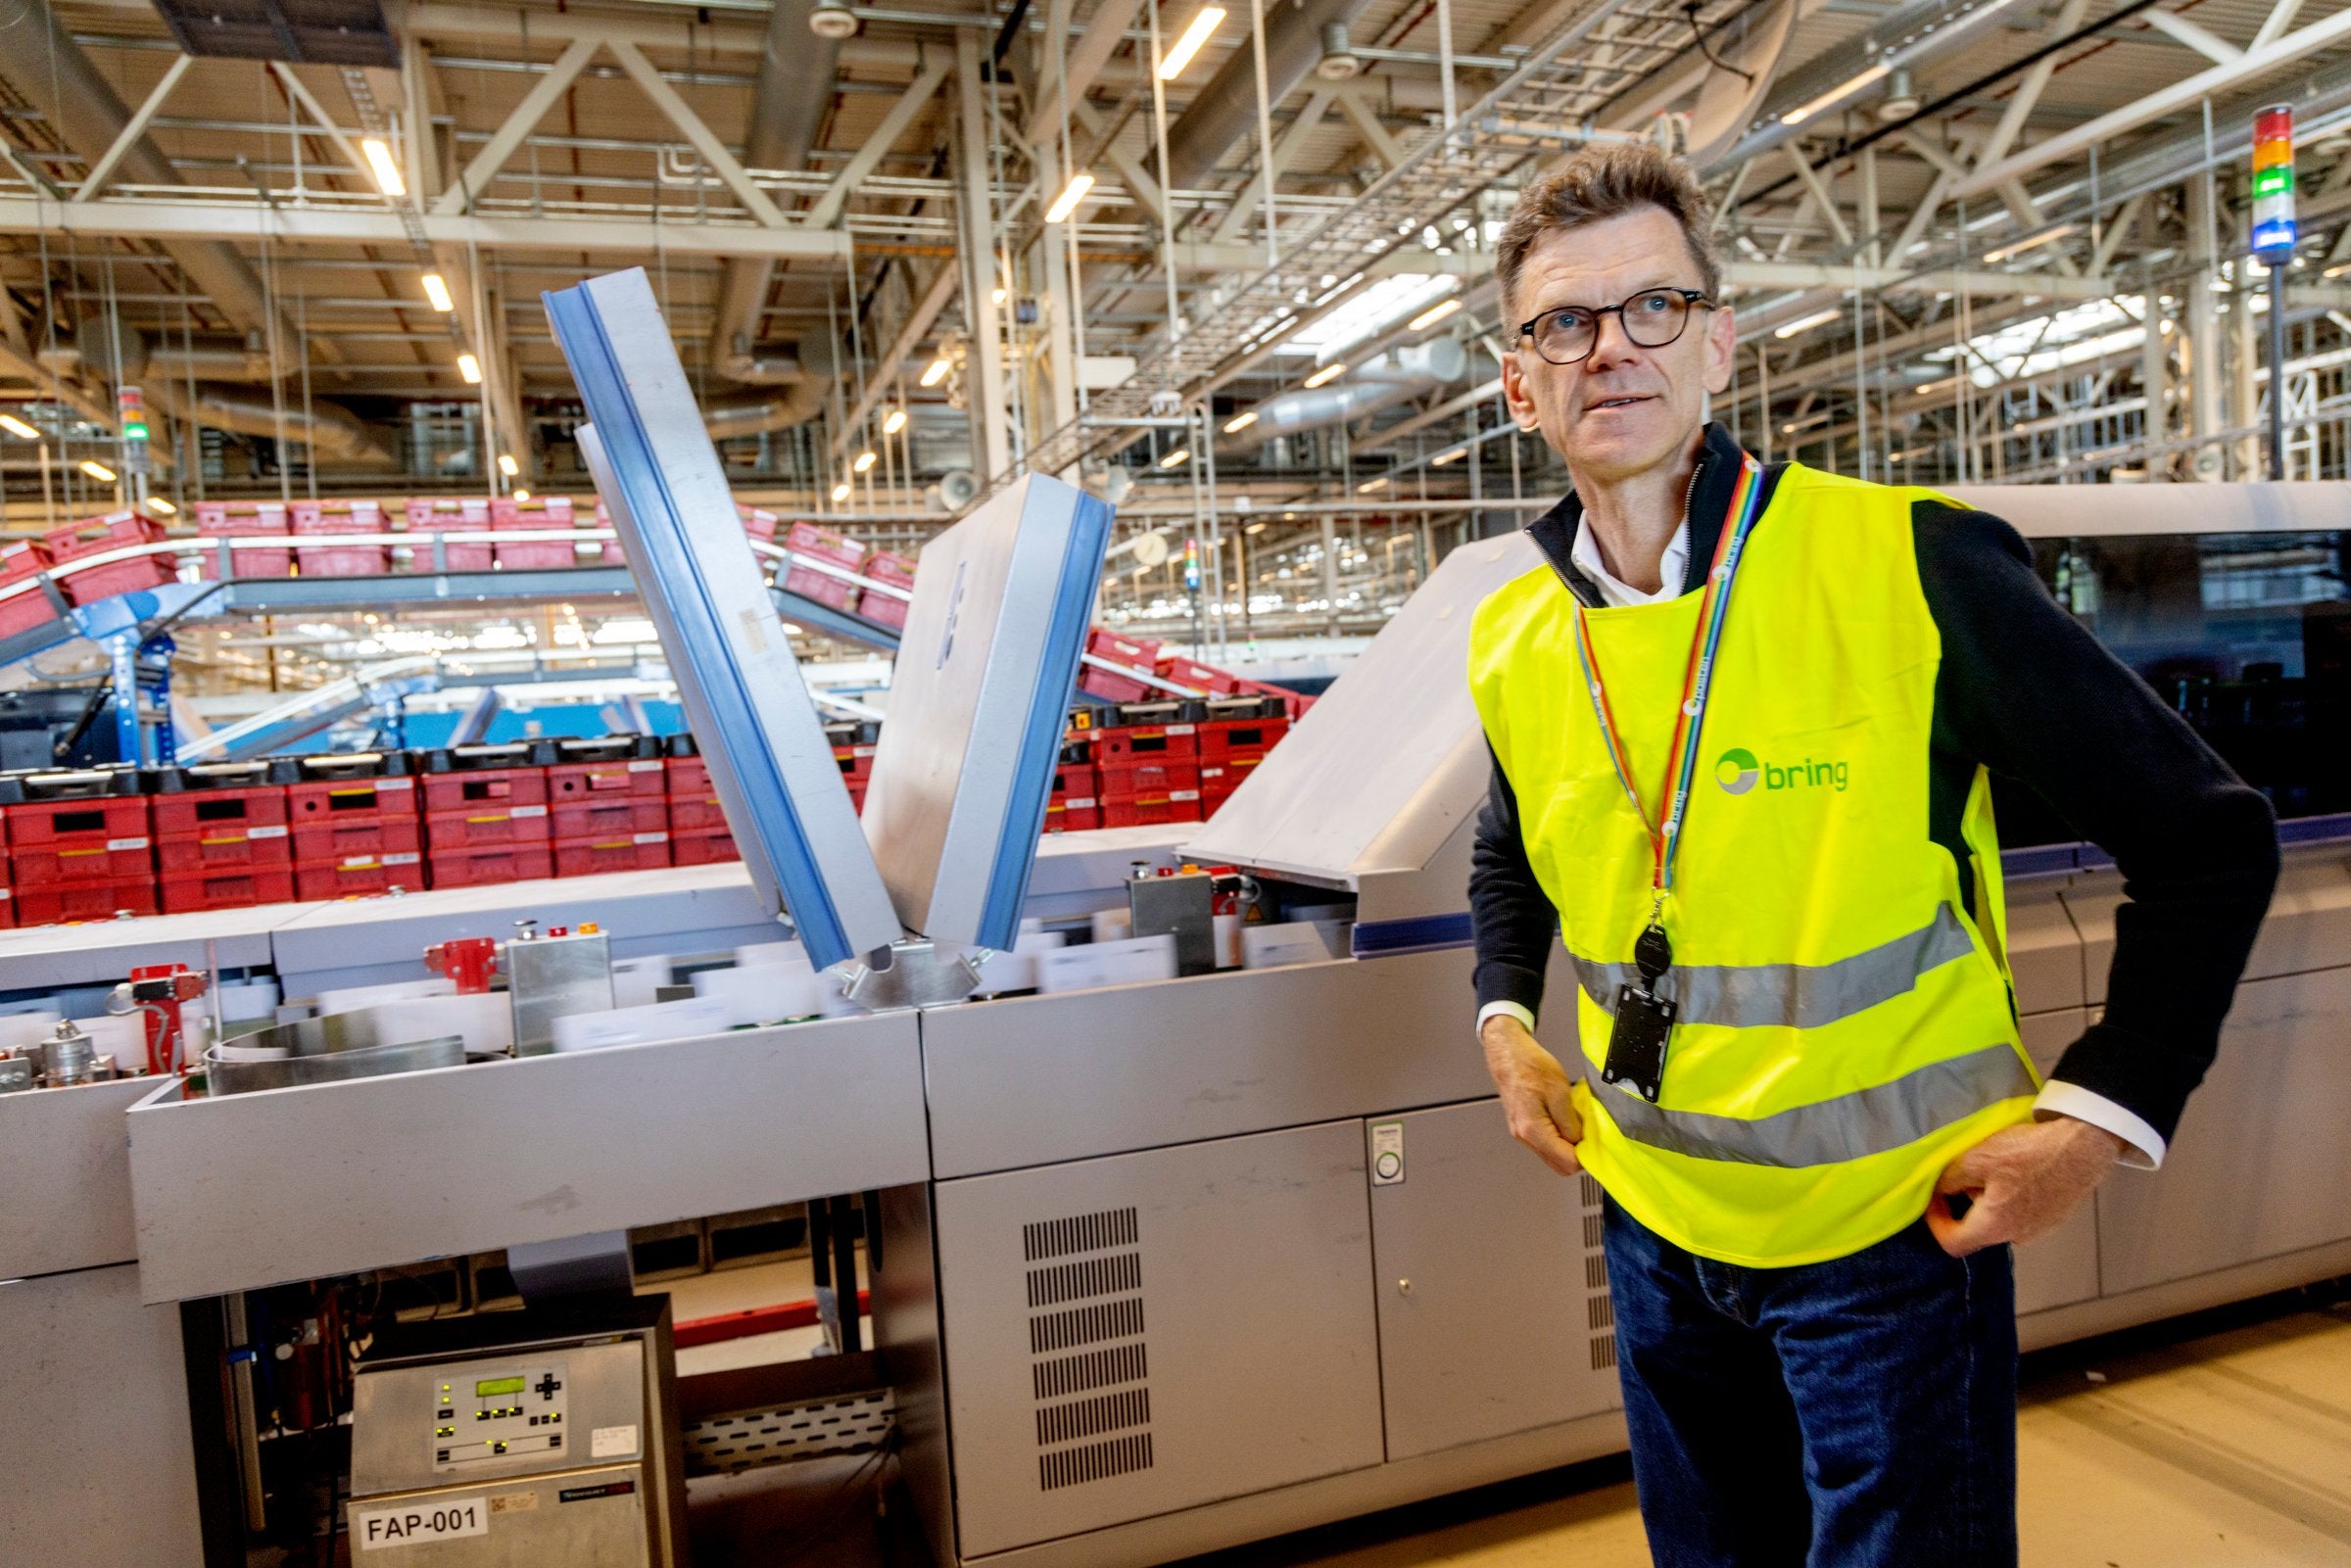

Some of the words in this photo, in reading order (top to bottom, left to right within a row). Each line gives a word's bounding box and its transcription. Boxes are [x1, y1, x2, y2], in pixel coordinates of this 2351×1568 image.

[1724, 536, 1745, 566] bring
[1694, 656, 1709, 700] posten
[1765, 758, 1848, 792] bring
[1670, 790, 1688, 821] bring
[367, 1506, 476, 1542] FAP-001
